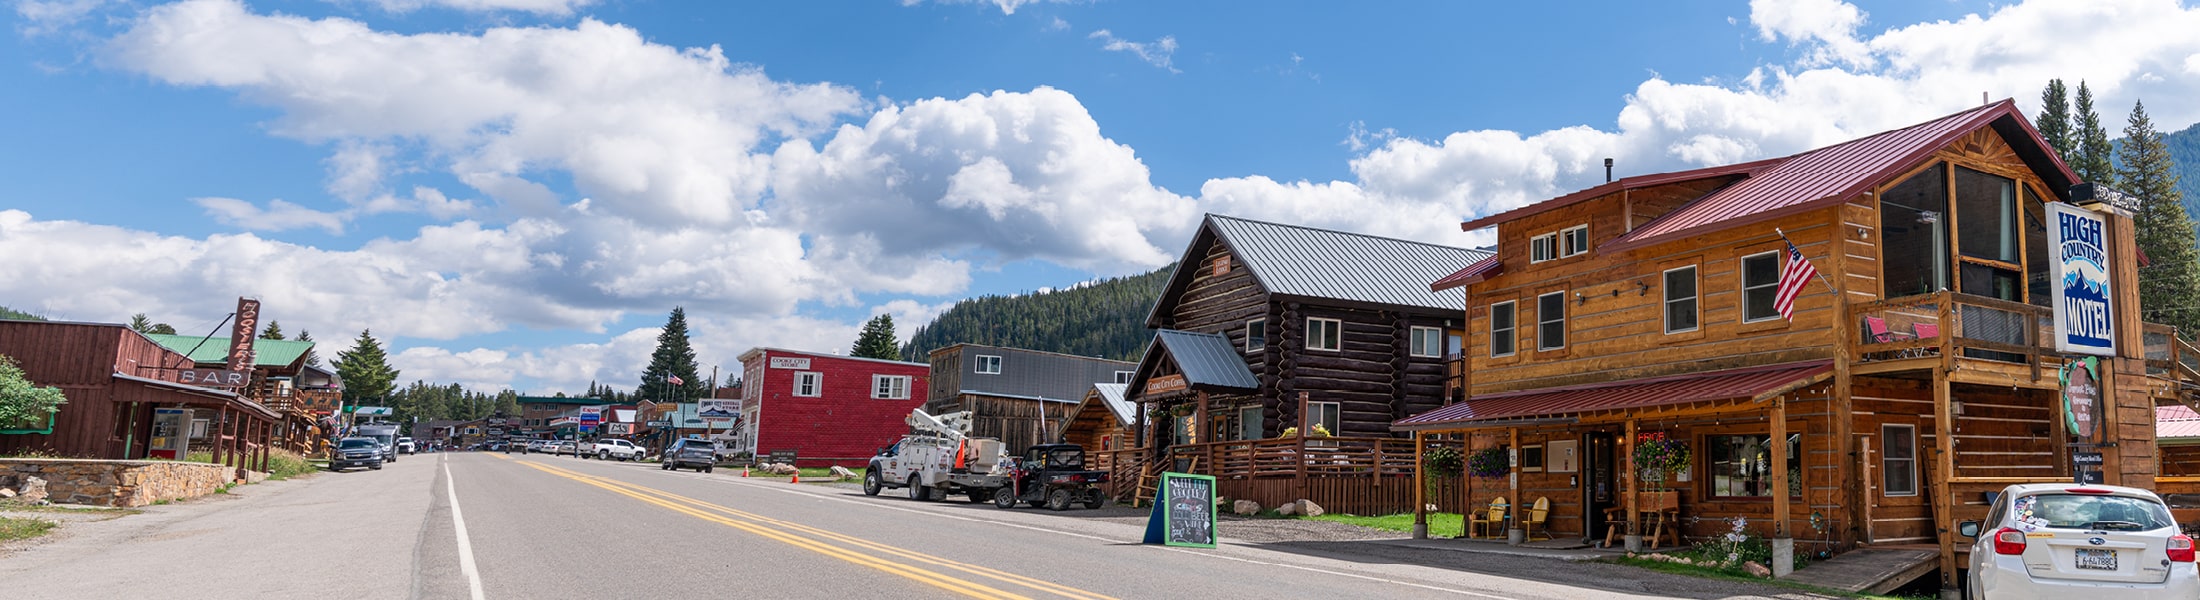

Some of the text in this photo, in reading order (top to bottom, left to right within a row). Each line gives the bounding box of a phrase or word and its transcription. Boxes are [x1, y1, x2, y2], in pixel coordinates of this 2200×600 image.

[2058, 211, 2104, 253] HIGH
[2061, 242, 2105, 271] COUNTRY
[2066, 296, 2111, 341] MOTEL
[182, 371, 242, 384] BAR
[1191, 512, 1210, 521] BEER
